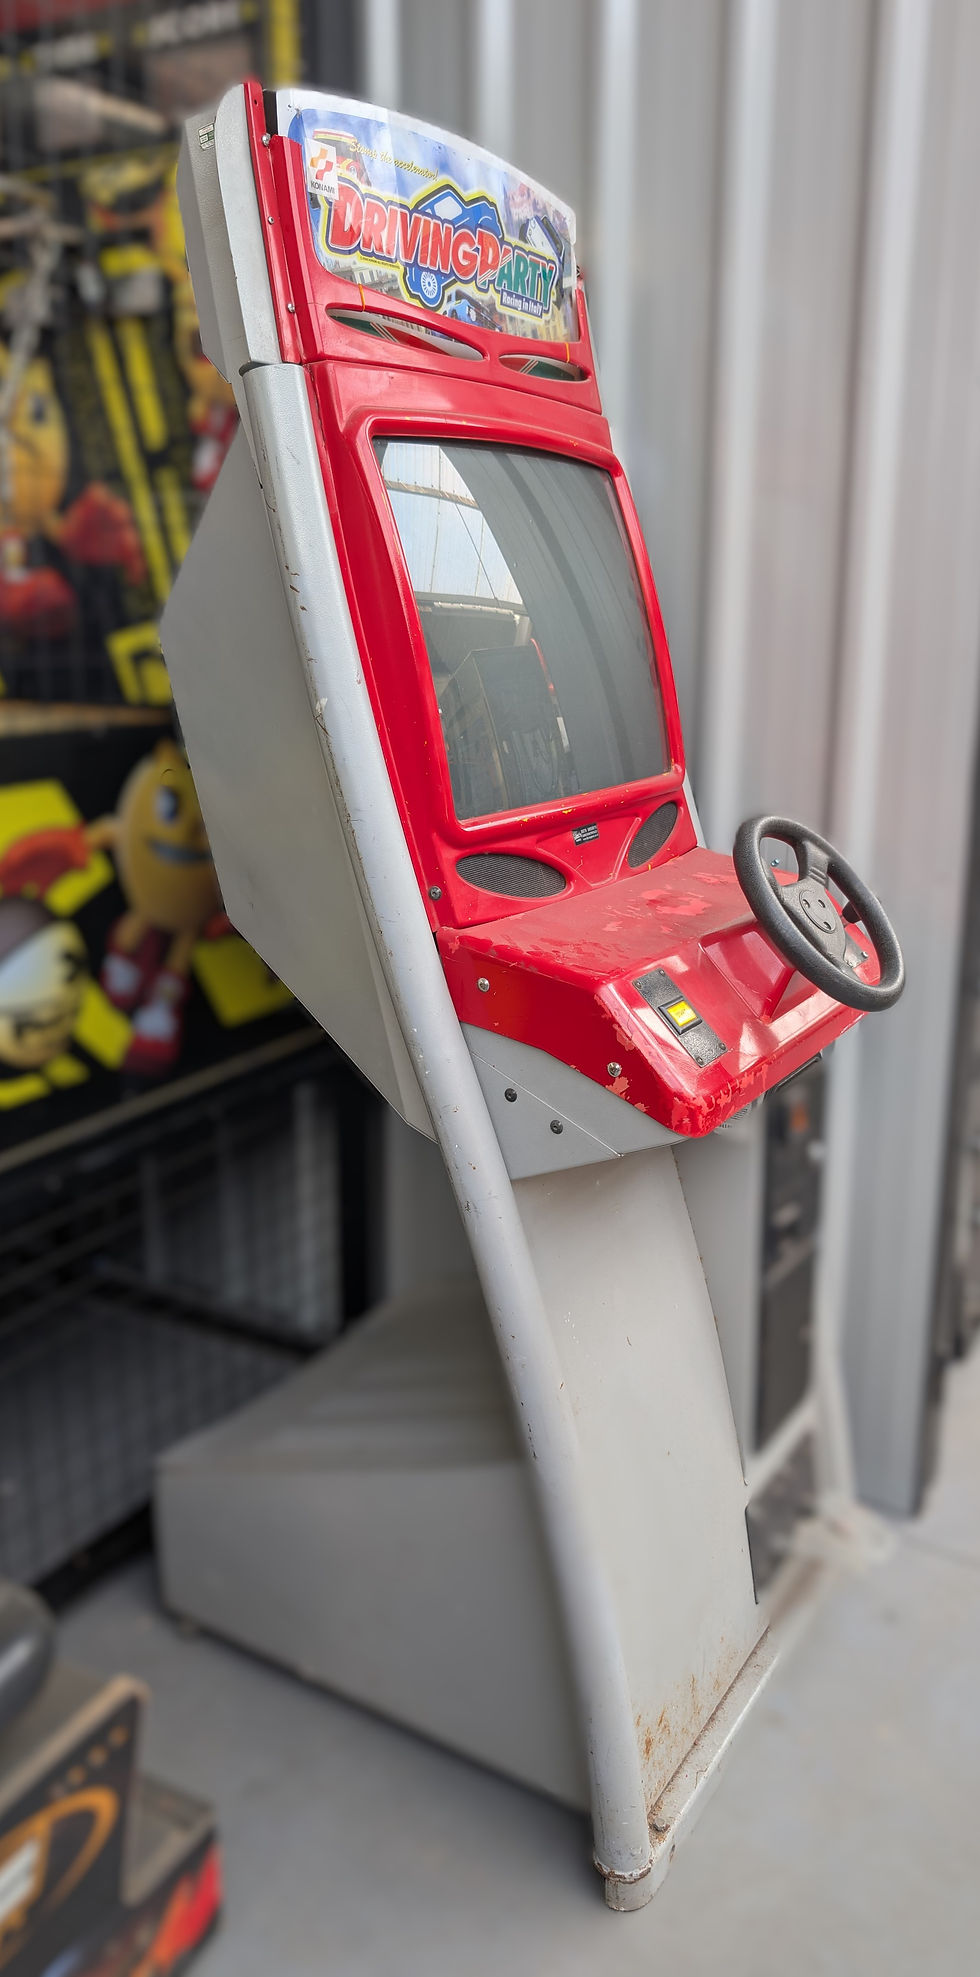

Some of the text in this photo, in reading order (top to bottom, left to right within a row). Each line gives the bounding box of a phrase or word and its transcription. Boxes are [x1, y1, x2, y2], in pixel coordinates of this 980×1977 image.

[349, 139, 379, 160] Stomp
[380, 151, 393, 164] the
[310, 180, 336, 195] KONAMI
[329, 181, 556, 311] DRIVING PARTY
[502, 292, 543, 316] Racing in Italy
